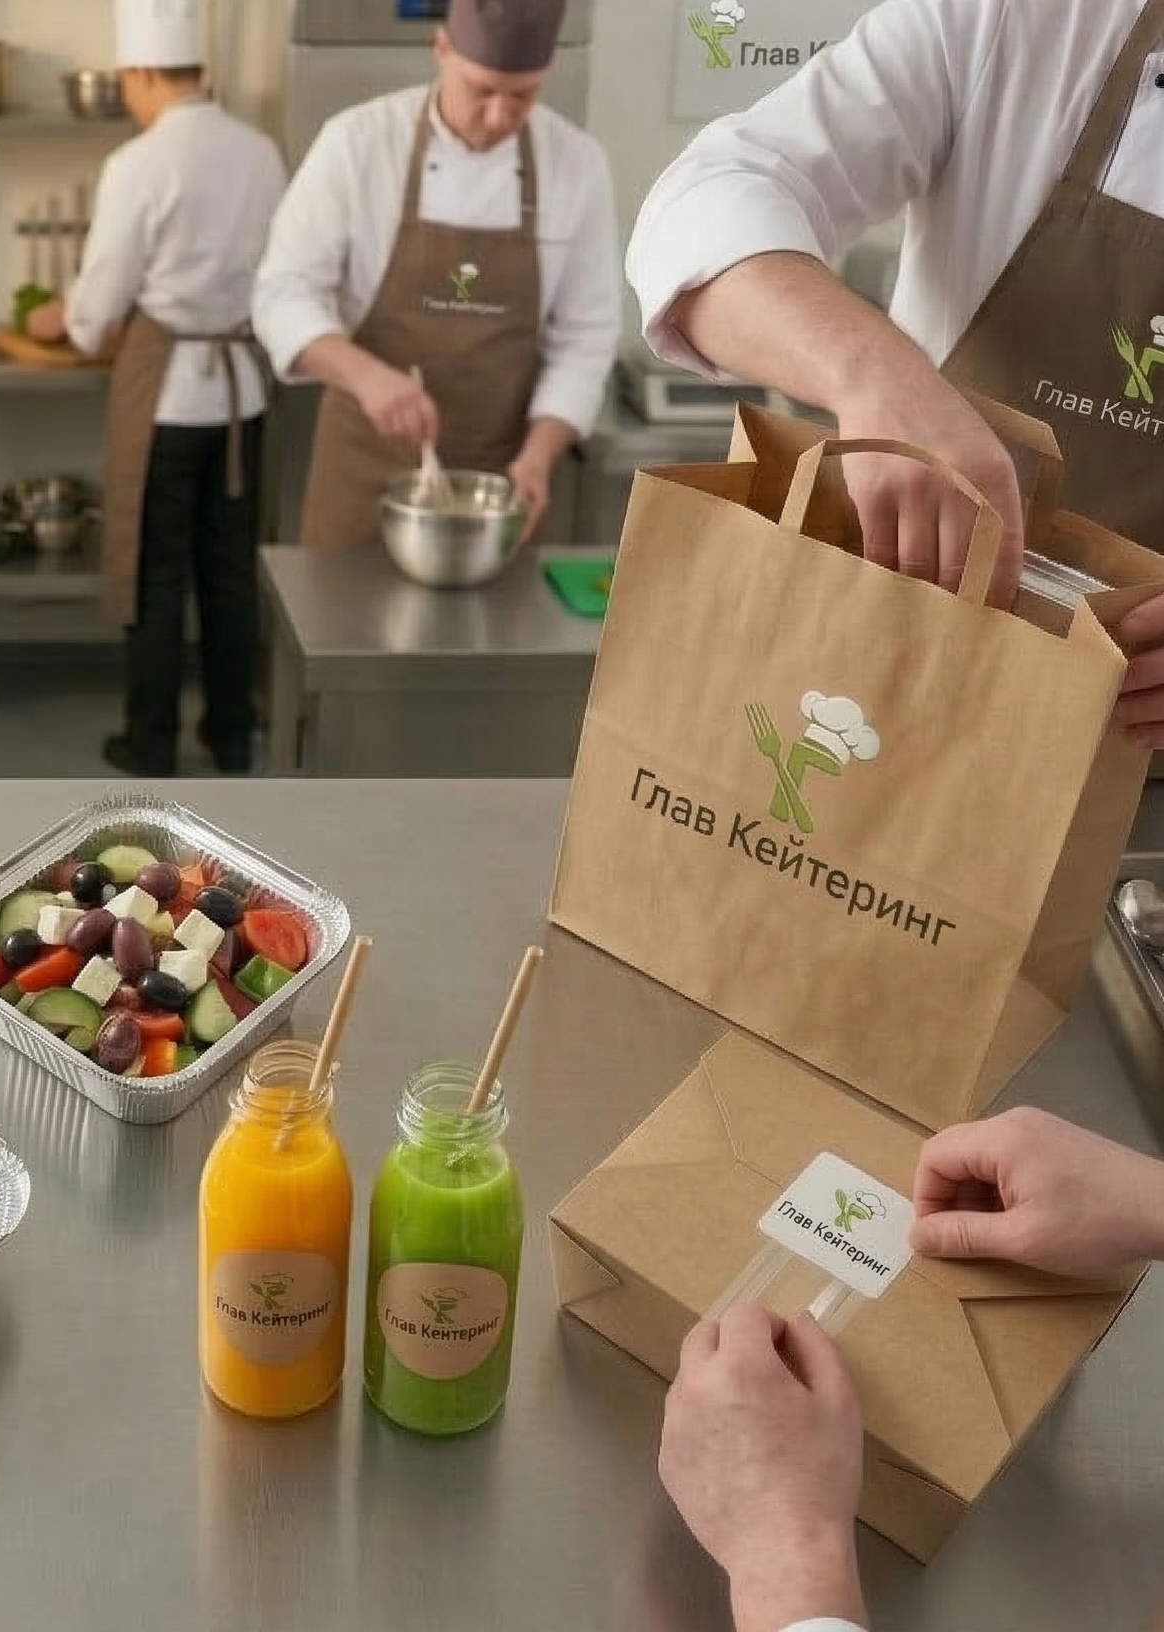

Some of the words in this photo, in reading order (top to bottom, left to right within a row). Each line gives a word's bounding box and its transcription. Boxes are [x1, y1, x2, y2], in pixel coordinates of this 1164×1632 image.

[740, 42, 799, 66] Глав
[1034, 379, 1094, 415] Глав
[630, 767, 716, 836] Глав
[727, 812, 957, 946] Кейтеринг
[777, 1200, 813, 1230] Глав
[813, 1222, 891, 1276] Кейтеринг
[216, 1296, 247, 1322] Глав
[251, 1300, 332, 1327] Кейтеринг
[385, 1306, 417, 1335] Глав
